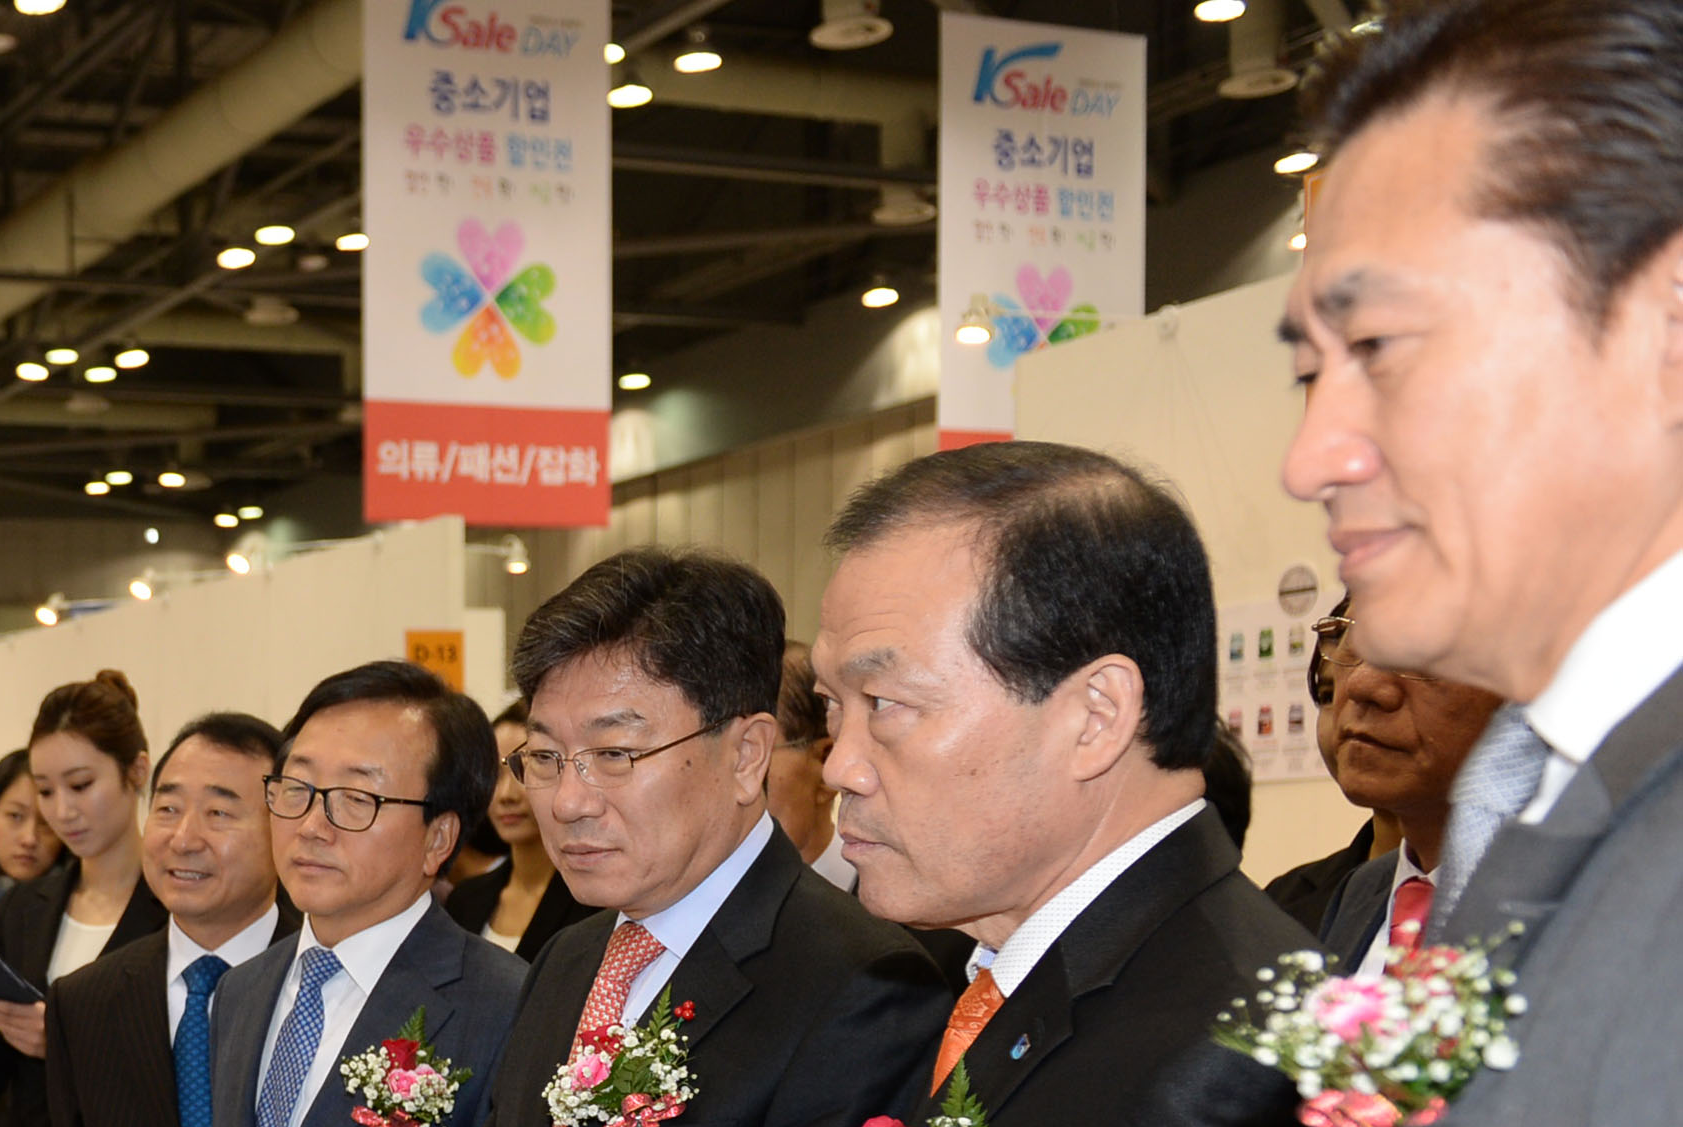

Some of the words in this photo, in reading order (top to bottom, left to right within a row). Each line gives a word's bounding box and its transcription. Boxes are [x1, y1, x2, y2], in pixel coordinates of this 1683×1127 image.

[522, 27, 580, 57] DAY
[429, 69, 551, 123] 중소기업
[1071, 91, 1121, 117] DAY
[404, 124, 496, 165] 우수상품
[993, 128, 1094, 179] 중소기업
[973, 178, 1050, 216] 우수상품
[377, 439, 600, 487] 의류/패션/잡화
